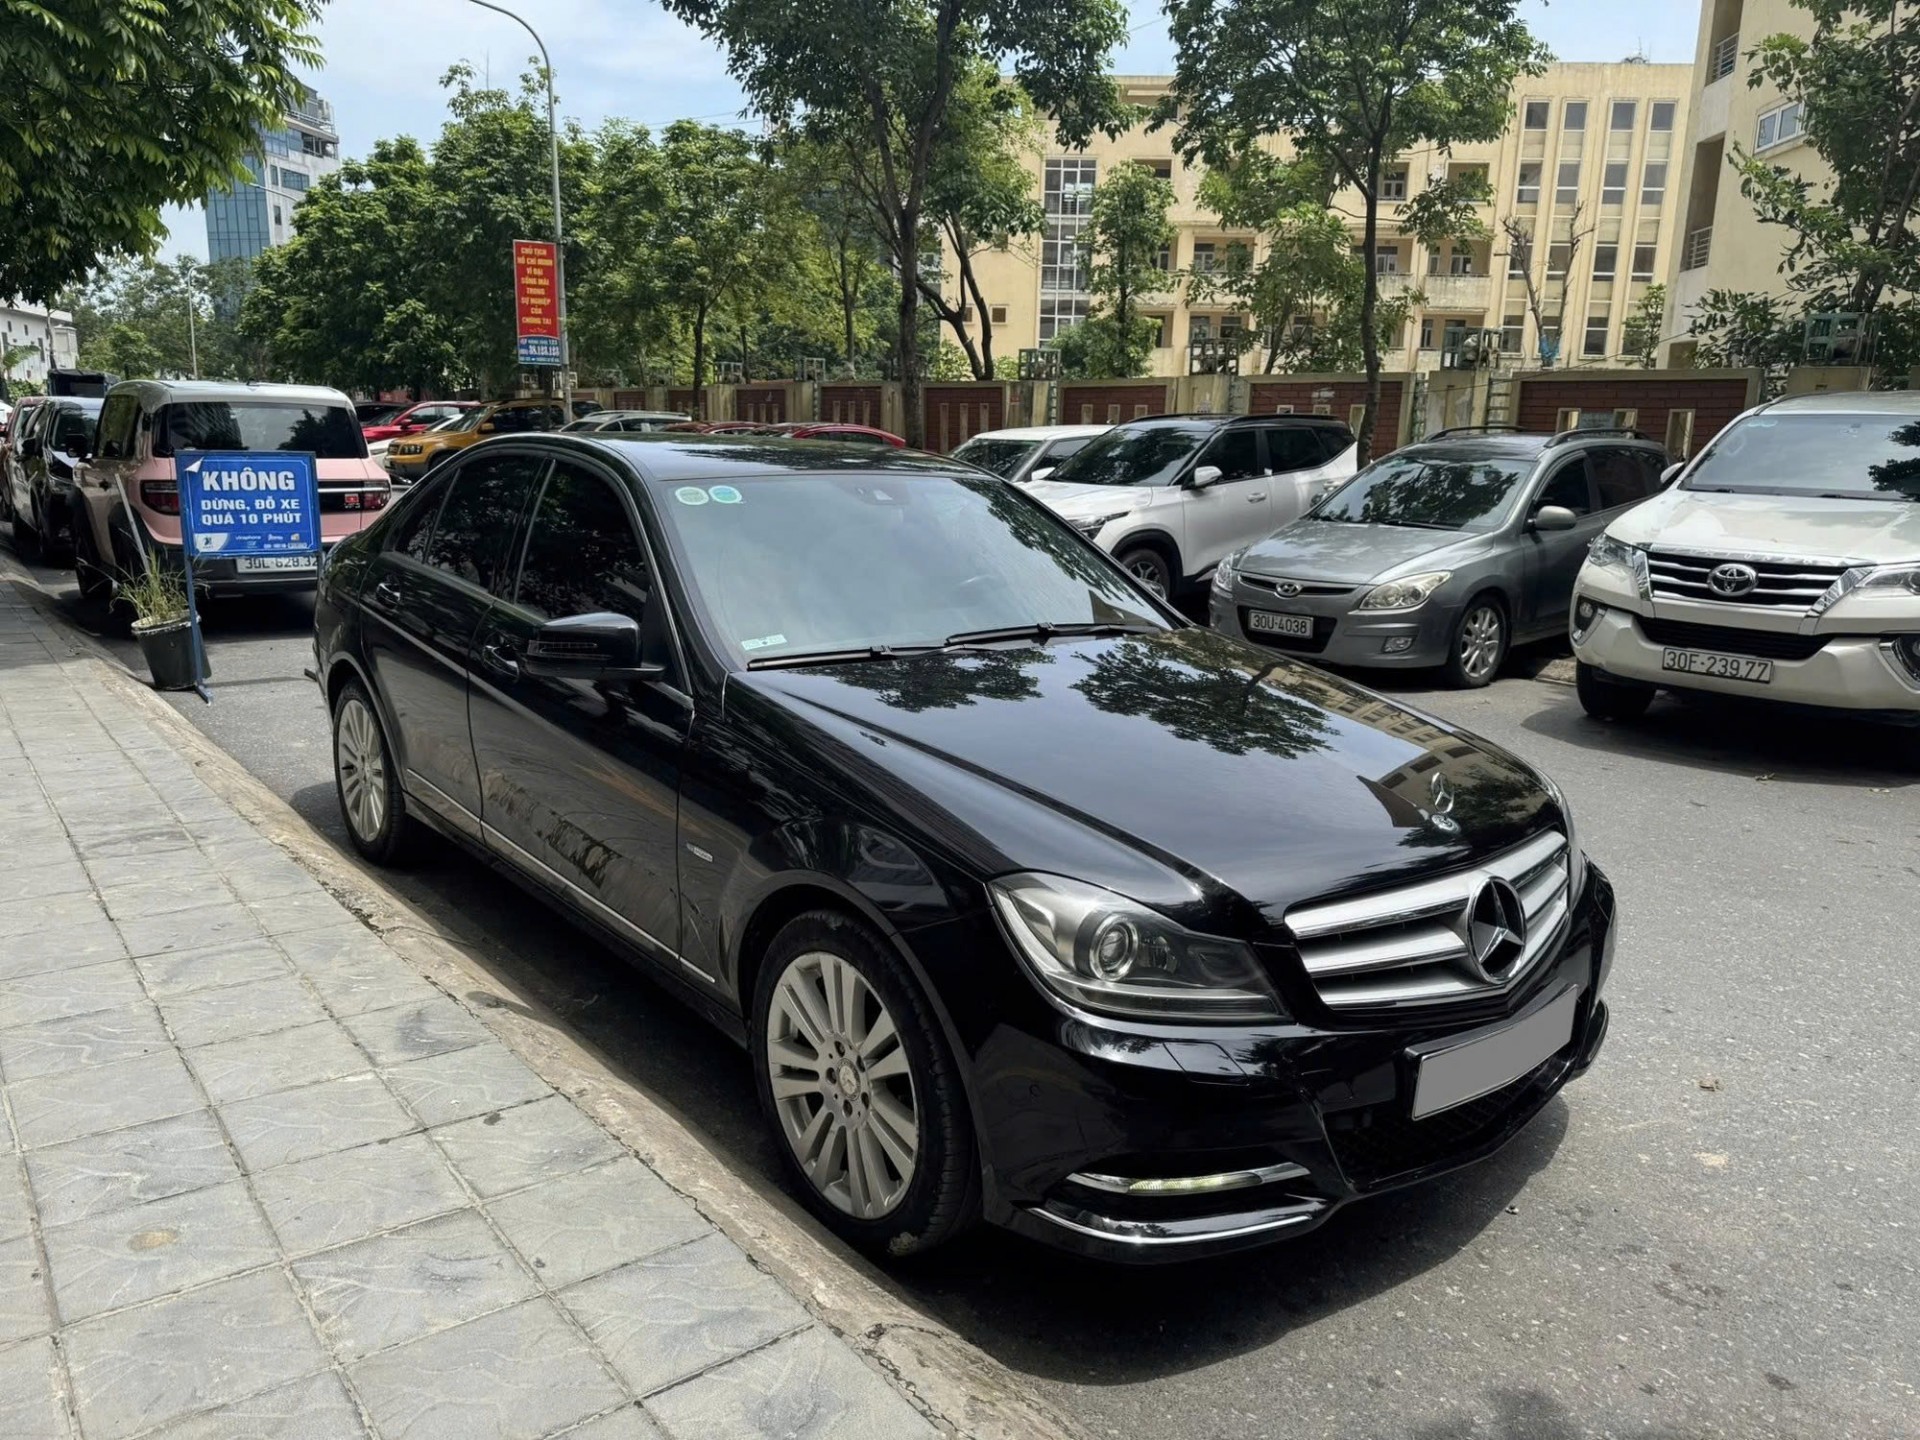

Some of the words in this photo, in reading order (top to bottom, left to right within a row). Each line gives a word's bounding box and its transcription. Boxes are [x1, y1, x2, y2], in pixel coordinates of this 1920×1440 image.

[202, 466, 295, 491] KHÔNG
[200, 497, 250, 511] DỪNG,
[254, 496, 276, 510] ĐỖ
[280, 499, 300, 510] XE
[202, 512, 235, 526] QUÁ
[240, 514, 258, 524] 10
[262, 510, 302, 524] PHÚT
[1253, 614, 1307, 634] 30U-4038
[1666, 651, 1769, 680] 30F-239.77
